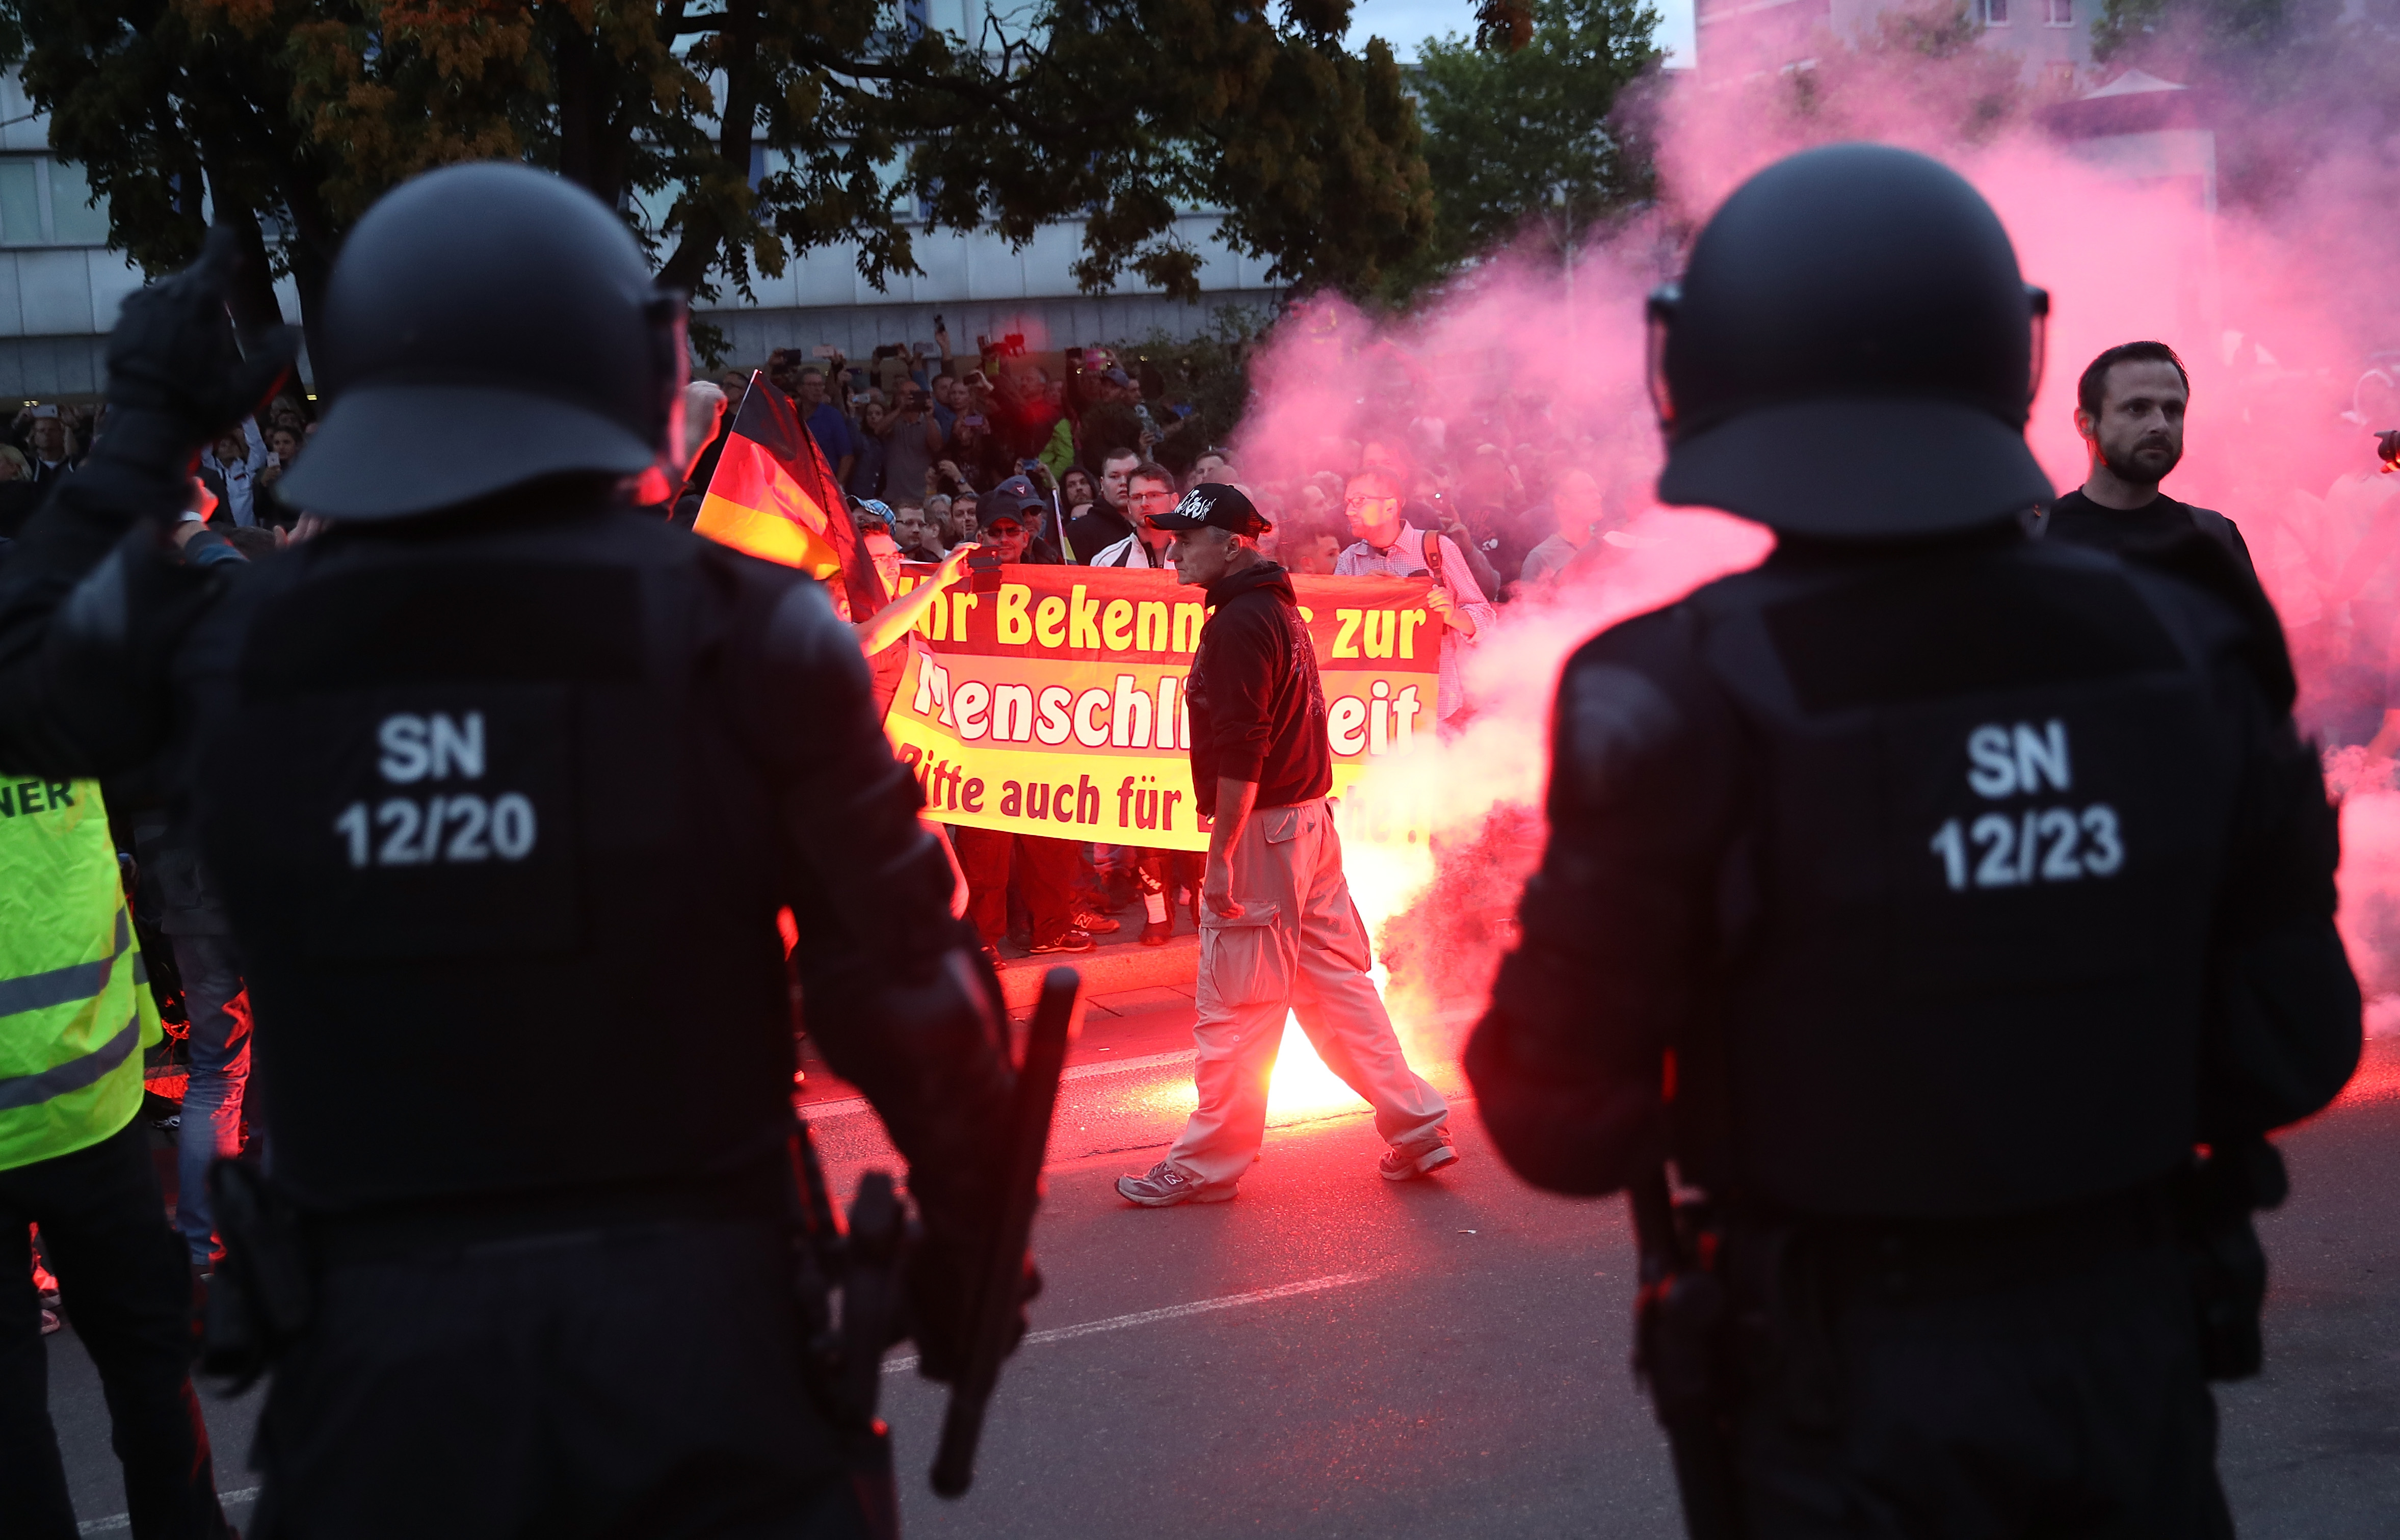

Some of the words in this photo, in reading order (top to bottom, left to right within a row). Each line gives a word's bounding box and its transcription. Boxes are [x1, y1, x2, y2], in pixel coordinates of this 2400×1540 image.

[996, 582, 1314, 653] Bekenn
[1332, 608, 1427, 659] zur
[912, 651, 1422, 758] Menschlieit
[379, 713, 484, 782] SN
[1969, 720, 2069, 796] SN
[337, 793, 535, 864] 12/20
[1000, 774, 1099, 825] auch
[1117, 776, 1181, 831] für
[1931, 804, 2123, 890] 12/23
